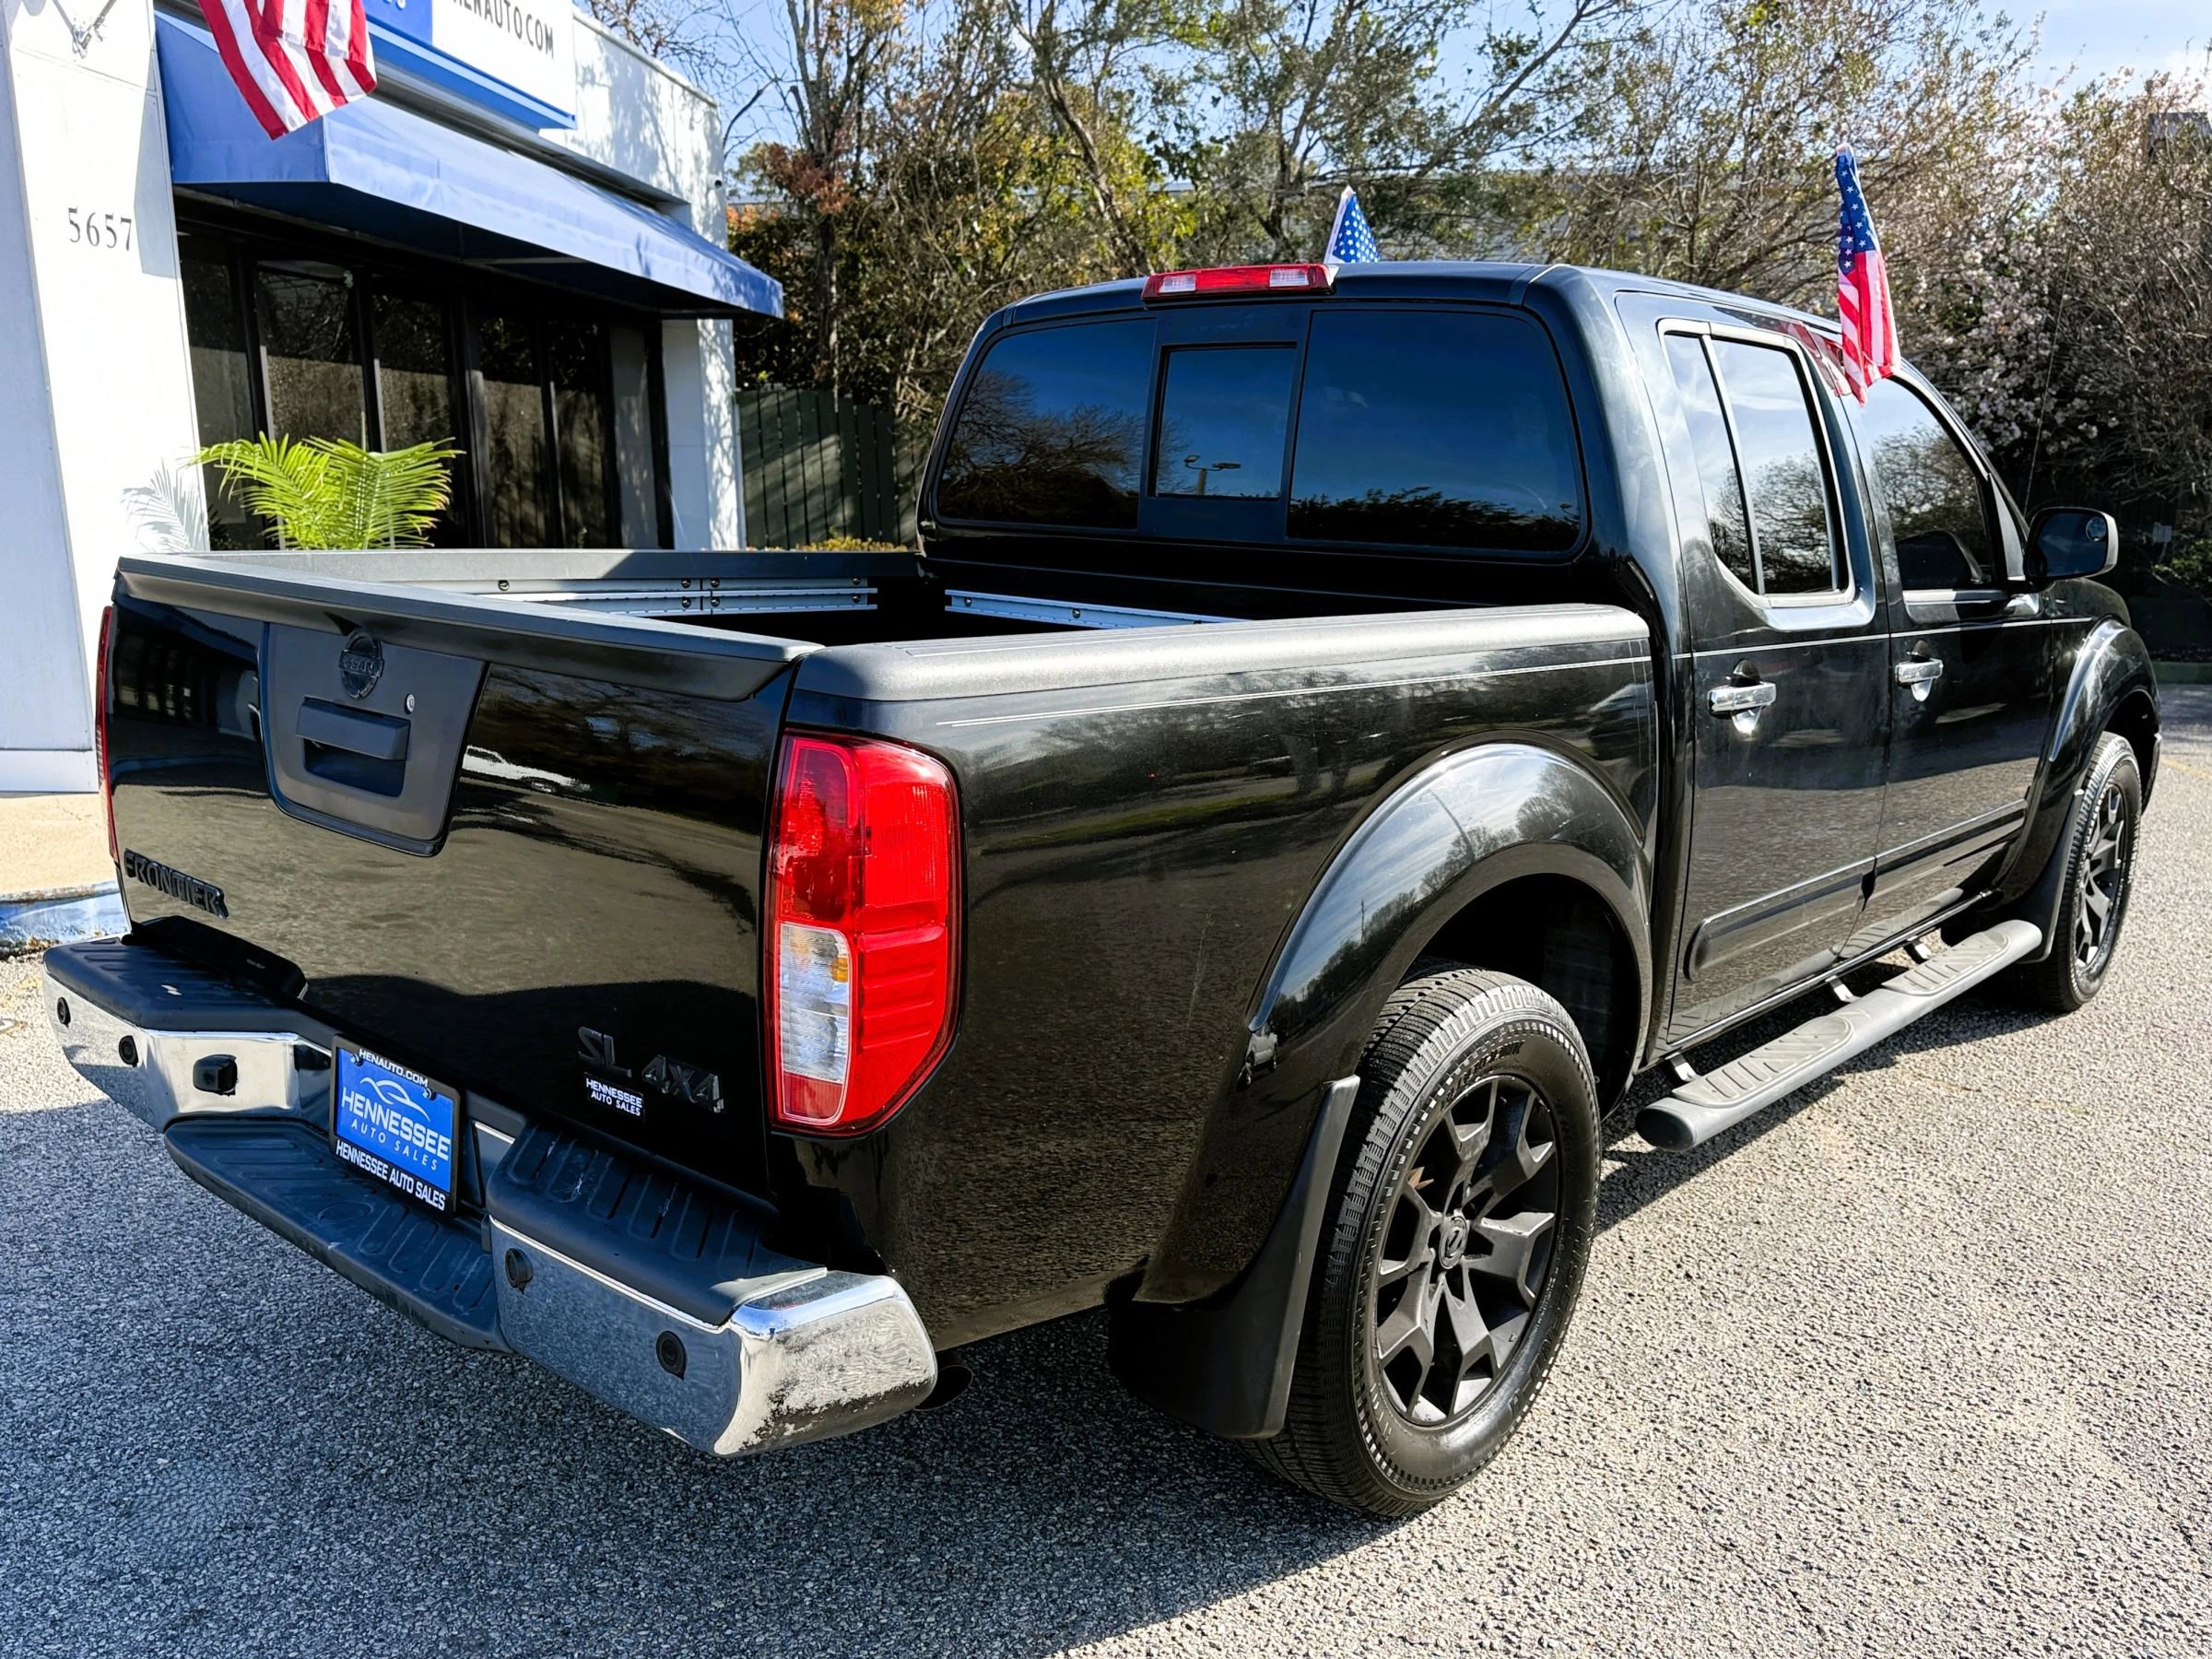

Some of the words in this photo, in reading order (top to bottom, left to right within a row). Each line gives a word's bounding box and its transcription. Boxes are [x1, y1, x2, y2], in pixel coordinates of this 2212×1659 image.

[67, 206, 132, 251] 5657
[124, 848, 229, 919] FRONTIER
[359, 1048, 429, 1088] HENAUTO.COM
[578, 1026, 632, 1078] SL
[586, 1077, 643, 1108] HENNESSEE
[591, 1091, 613, 1105] AUTO
[616, 1100, 641, 1116] SALES
[341, 1087, 451, 1161] HENNESSEE
[351, 1120, 386, 1143] AUTO
[394, 1140, 437, 1171] SALES
[335, 1139, 389, 1181] HENNESSEE
[389, 1168, 414, 1194] AUTO
[415, 1182, 446, 1211] SALES
